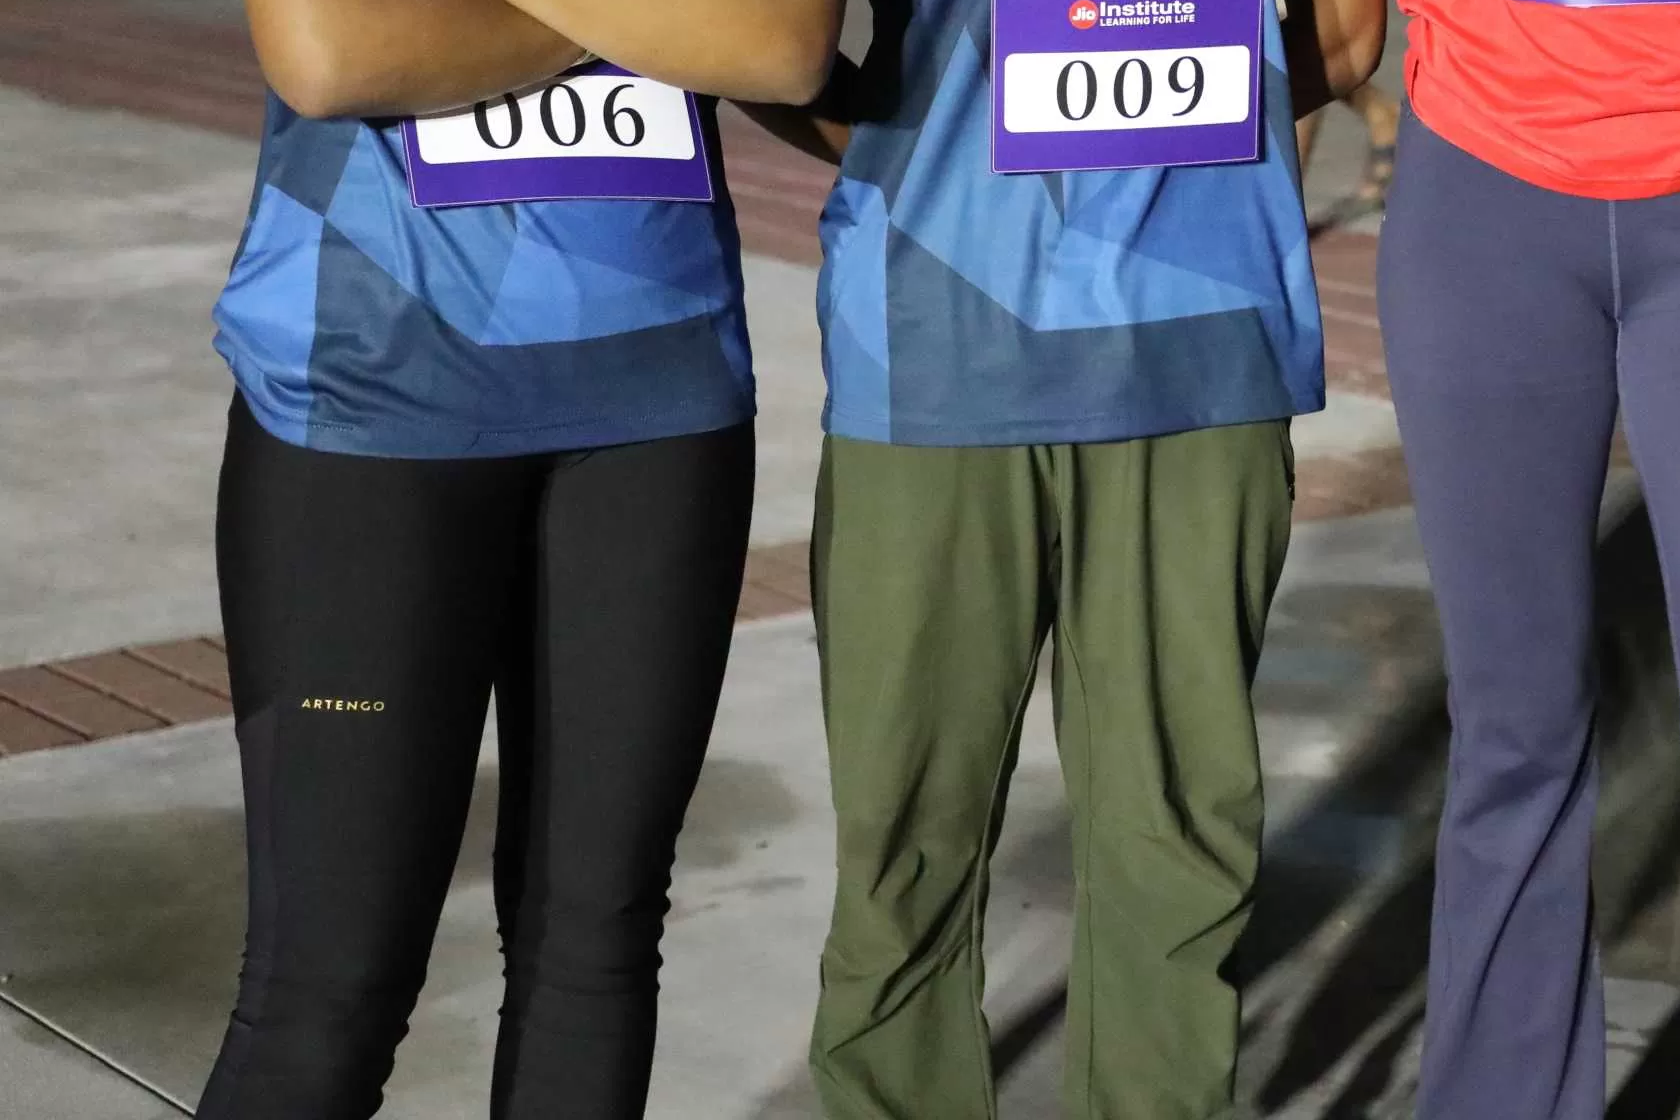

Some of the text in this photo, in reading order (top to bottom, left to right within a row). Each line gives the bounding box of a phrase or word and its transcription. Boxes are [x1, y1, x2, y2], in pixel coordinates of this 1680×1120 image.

[1072, 0, 1196, 21] Jio Institute
[1100, 14, 1196, 27] LEARNING FOR LIFE
[1056, 55, 1205, 121] 009
[473, 83, 646, 150] 006
[301, 698, 385, 712] ARTENGO
